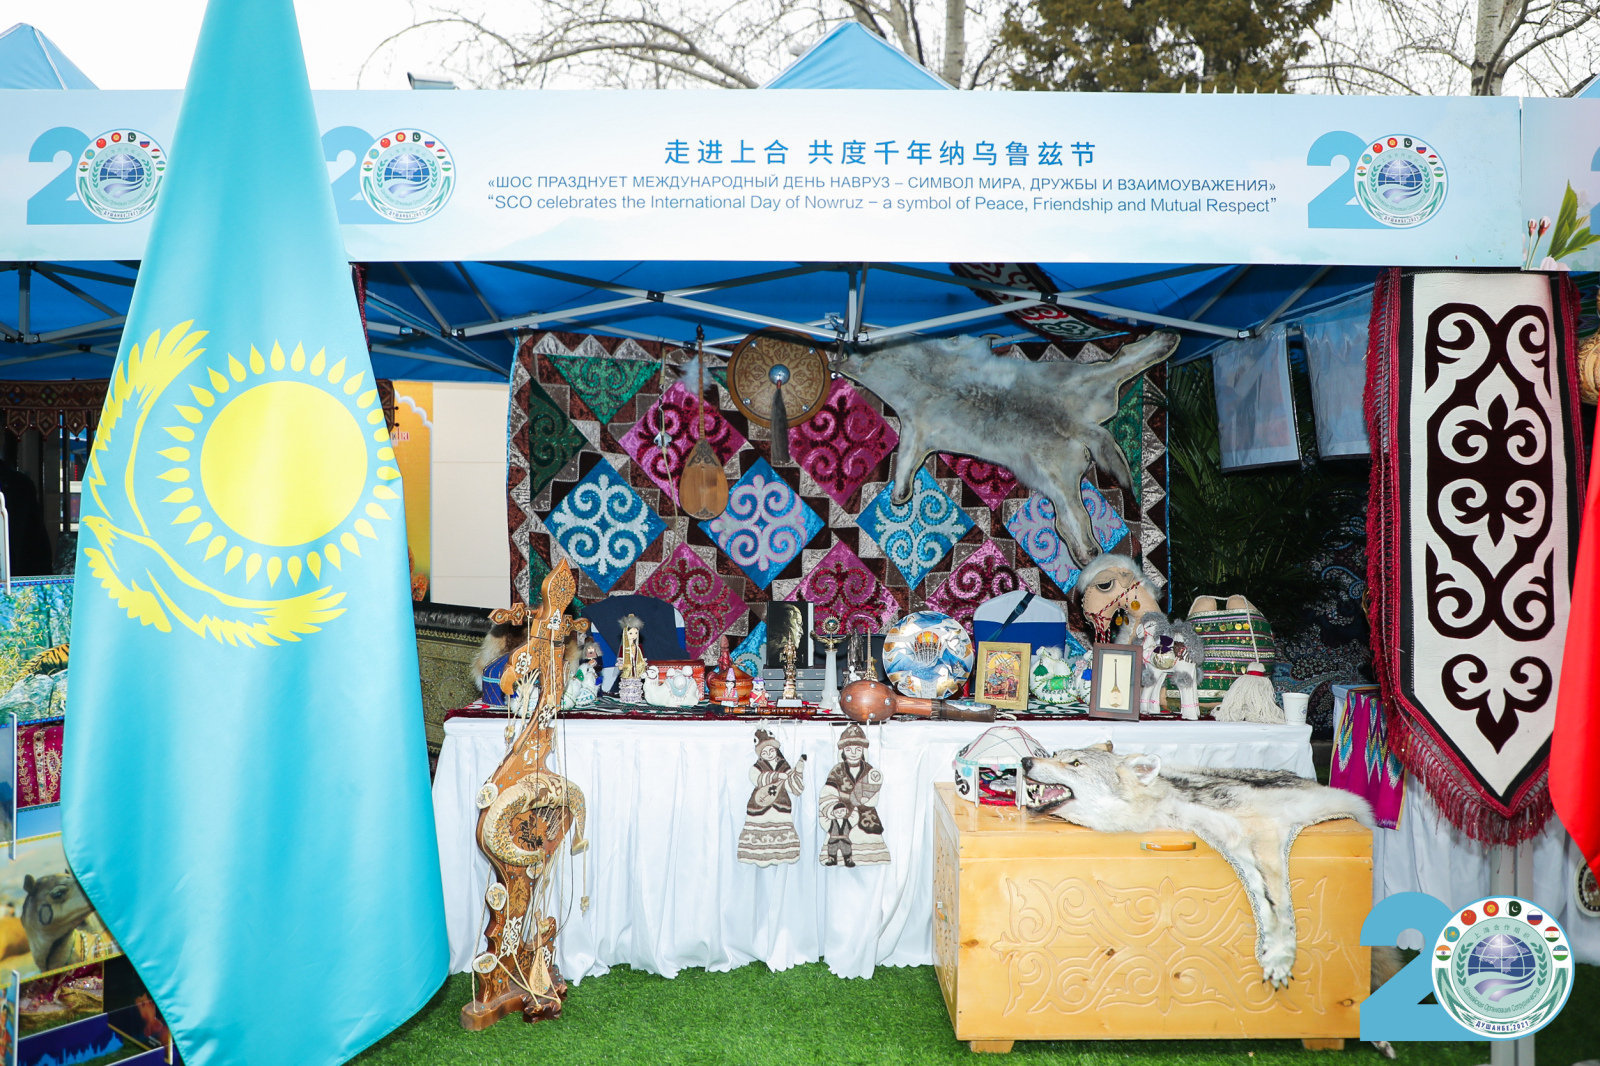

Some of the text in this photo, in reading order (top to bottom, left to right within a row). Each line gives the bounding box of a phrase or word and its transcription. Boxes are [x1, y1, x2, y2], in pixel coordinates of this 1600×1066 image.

[664, 139, 1096, 167] 走进上合 共度千年纳乌鲁兹节
[488, 176, 533, 188] «ШОС
[537, 175, 628, 190] ПРАЗДНУЕТ
[632, 173, 779, 190] МЕЖДУНАРОДНЫЙ
[783, 176, 826, 190] ДЕНЬ
[830, 176, 890, 189] НАВРУЗ
[908, 177, 974, 189] СИМВОЛ
[979, 177, 1025, 191] МИРА,
[1030, 178, 1097, 192] ДРУЖБЫ
[1102, 179, 1113, 190] И
[1117, 179, 1276, 192] ВЗАИМОУВАЖЕНИЯ»
[537, 195, 617, 209] celebrates
[622, 195, 646, 209] the
[651, 195, 746, 209] International
[750, 195, 781, 212] Day
[785, 195, 800, 209] of
[805, 195, 864, 209] Nowruz
[882, 198, 892, 210] a
[896, 196, 951, 212] symbol
[955, 196, 970, 210] of
[975, 196, 1028, 212] Peace,
[1033, 196, 1113, 214] Friendship
[1117, 198, 1146, 212] and
[1151, 198, 1202, 212] Mutual
